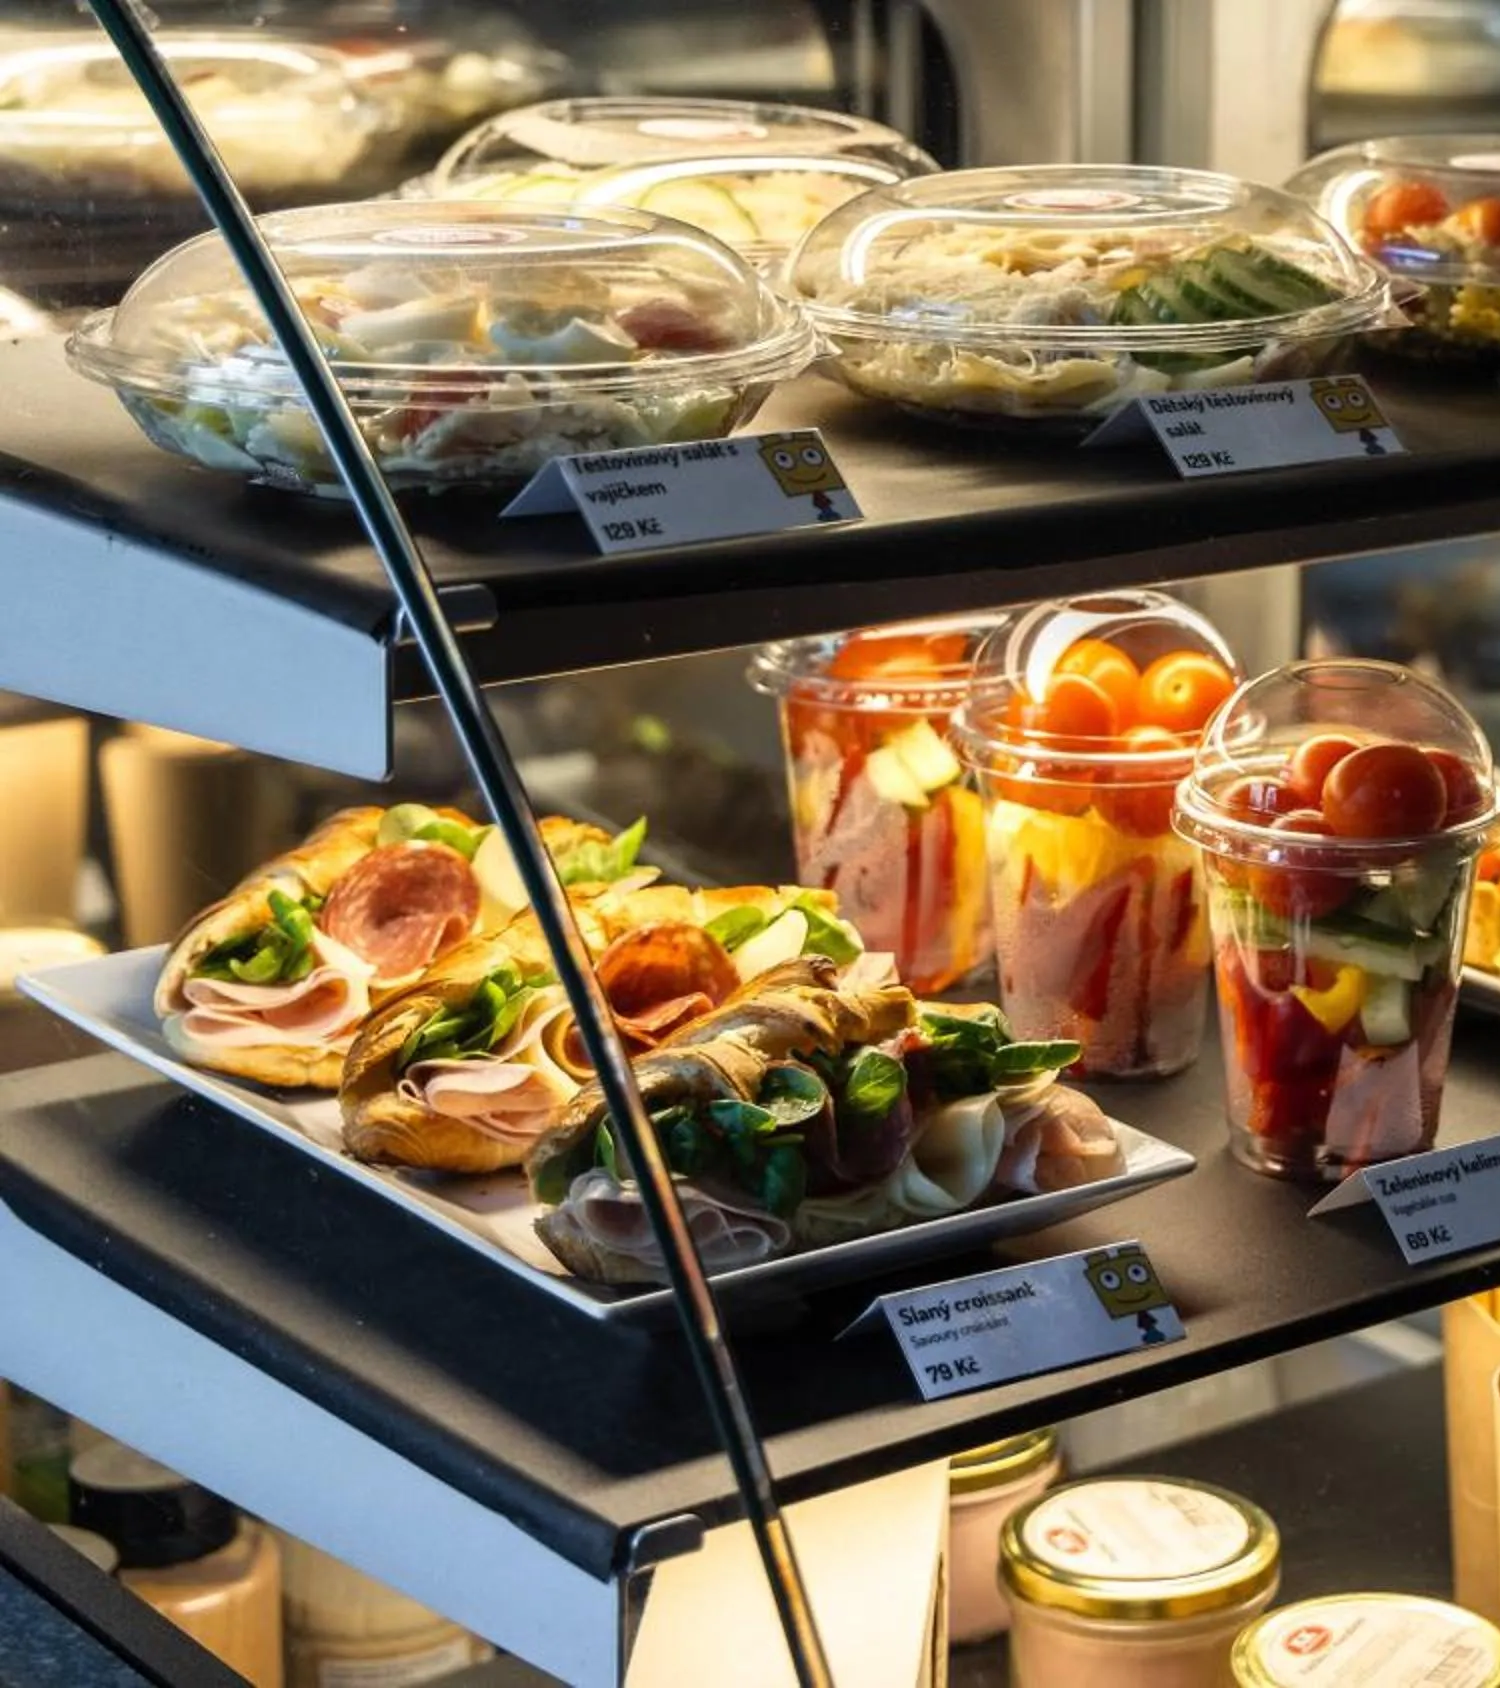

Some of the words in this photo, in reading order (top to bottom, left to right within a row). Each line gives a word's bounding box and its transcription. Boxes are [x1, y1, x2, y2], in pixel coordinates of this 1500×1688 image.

[1148, 395, 1204, 414] Dětský
[1165, 421, 1206, 437] salát
[682, 443, 726, 461] salát
[1182, 454, 1212, 469] 129
[1211, 450, 1235, 467] Kč
[585, 481, 668, 505] vajíčkem
[602, 521, 635, 541] 129
[636, 518, 664, 536] Kč
[1376, 1163, 1460, 1196] Zeleninový
[1405, 1230, 1429, 1250] 69
[1428, 1224, 1453, 1245] Kč
[898, 1300, 950, 1326] Slaný
[953, 1281, 1036, 1313] croissant
[909, 1327, 960, 1350] Savoury
[959, 1317, 1010, 1336] croissant
[925, 1363, 954, 1385] 79
[953, 1356, 981, 1376] Kč
